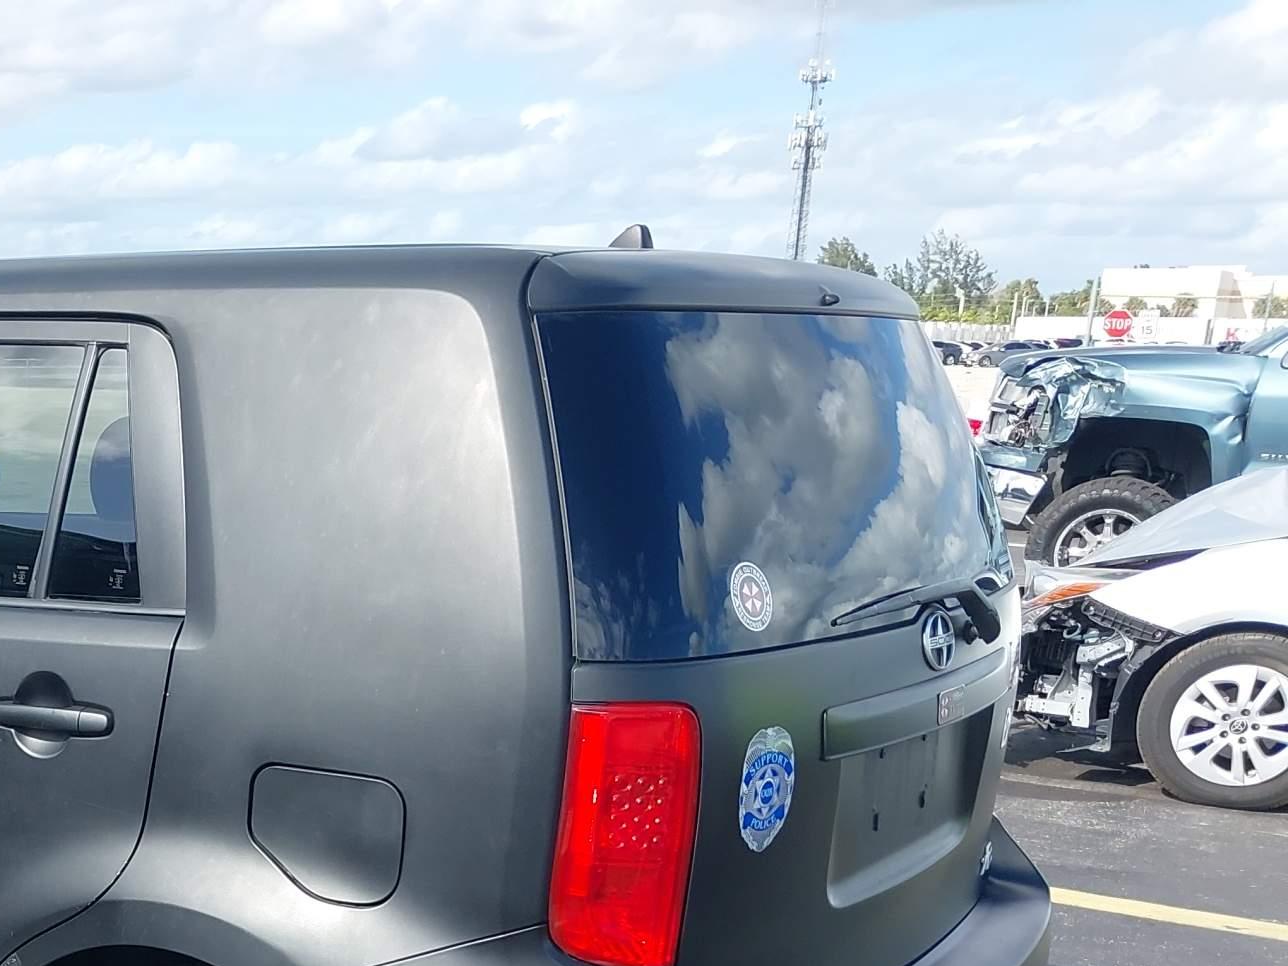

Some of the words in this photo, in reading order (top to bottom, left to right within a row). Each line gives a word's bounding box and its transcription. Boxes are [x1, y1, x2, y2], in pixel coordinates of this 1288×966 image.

[1104, 318, 1132, 330] STOP
[1141, 325, 1153, 335] 15
[749, 752, 789, 777] SUPPORT
[761, 786, 774, 799] OUR
[750, 815, 777, 830] POLICE
